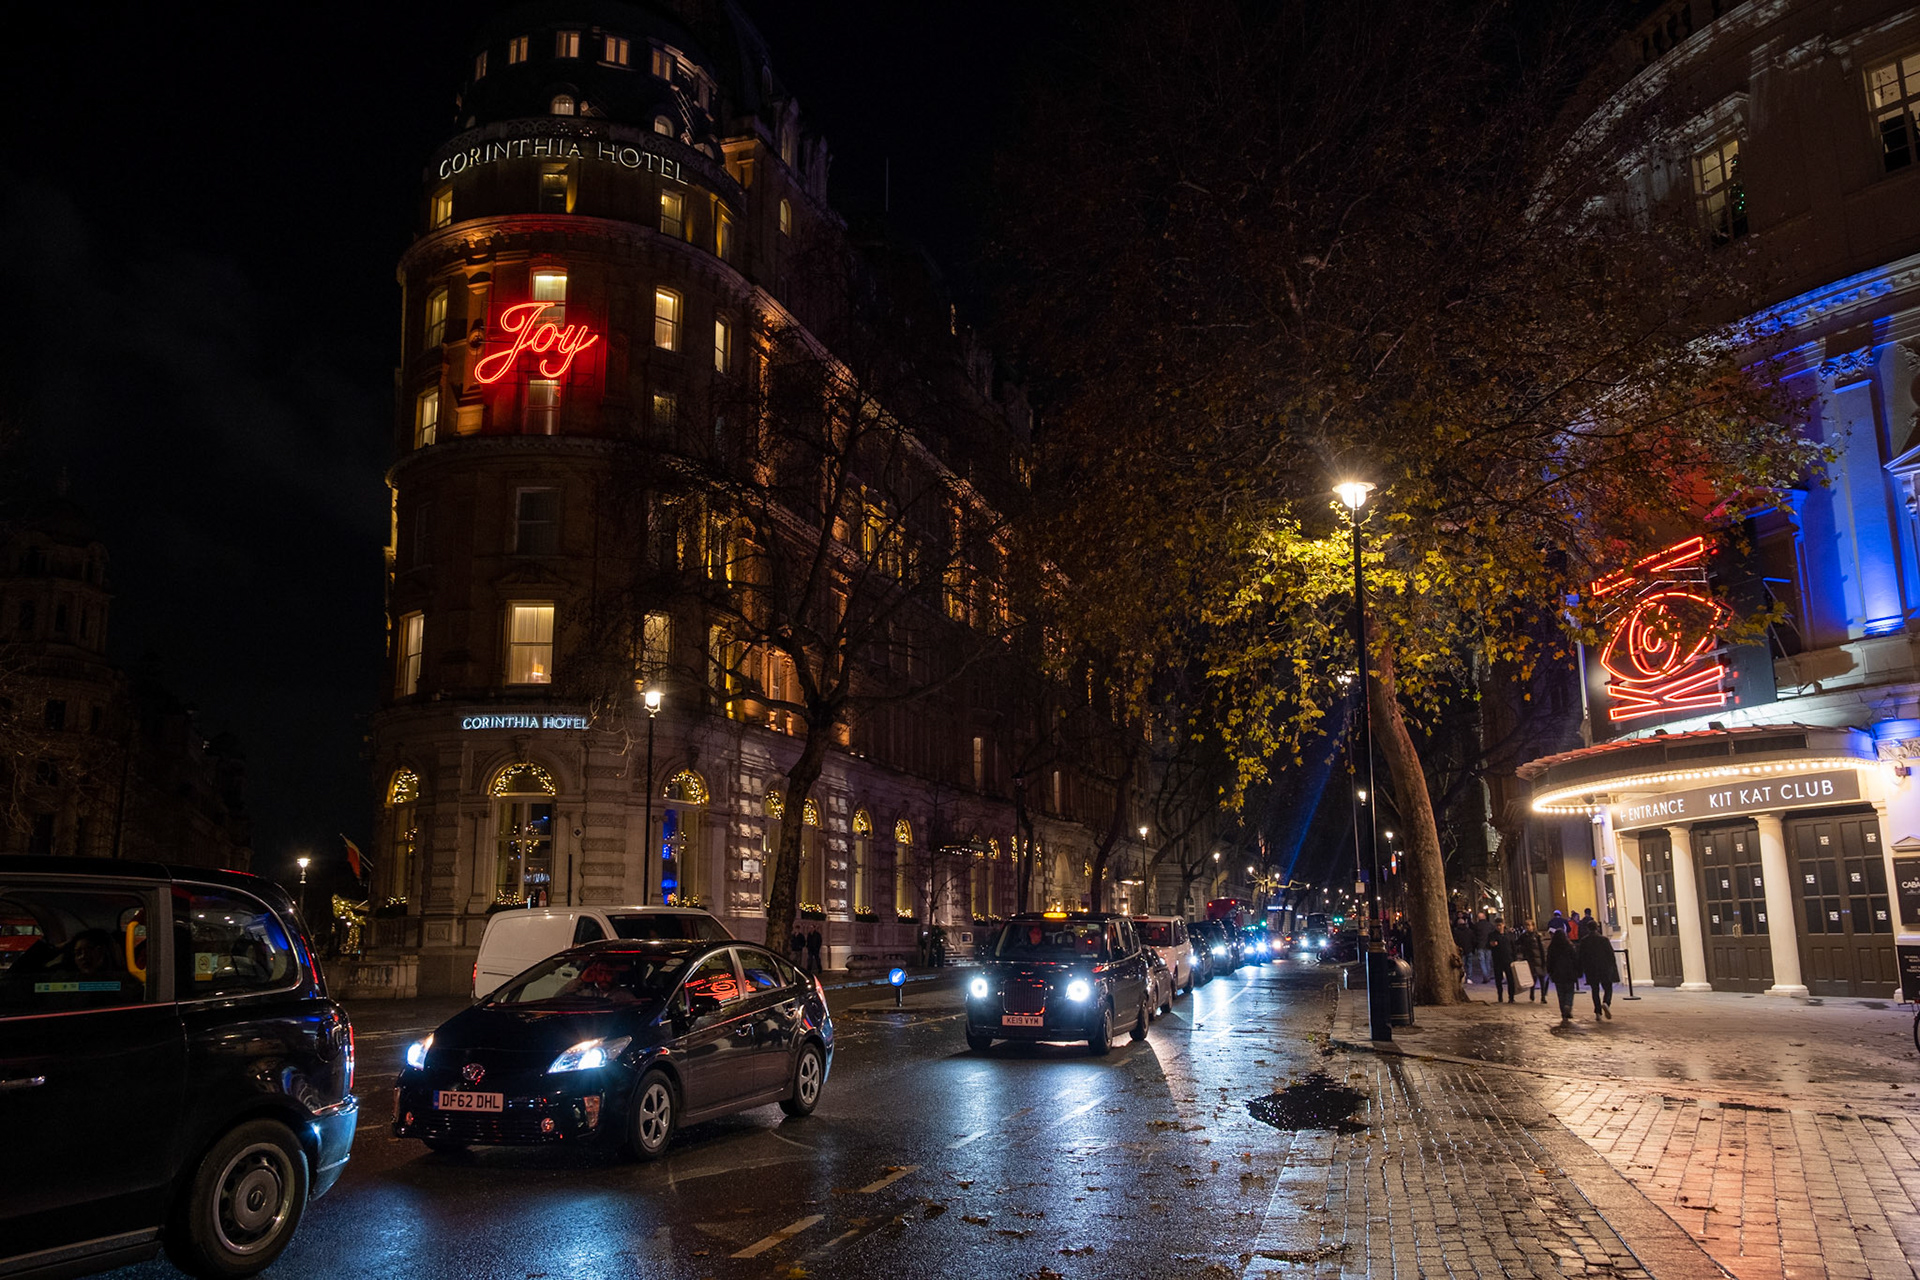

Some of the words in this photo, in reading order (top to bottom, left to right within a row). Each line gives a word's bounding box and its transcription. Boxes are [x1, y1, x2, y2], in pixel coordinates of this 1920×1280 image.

[440, 138, 585, 180] CORINTHIA
[598, 141, 689, 186] HOTEL
[474, 302, 599, 384] Joy
[462, 716, 539, 730] CORINTHIA
[543, 716, 590, 730] HOTEL
[1709, 791, 1733, 809] KIT
[1740, 786, 1772, 805] KAT
[1780, 779, 1835, 801] CLUB
[1628, 798, 1685, 821] ENTRANCE
[442, 1093, 473, 1108] DF62
[476, 1094, 500, 1109] DHL
